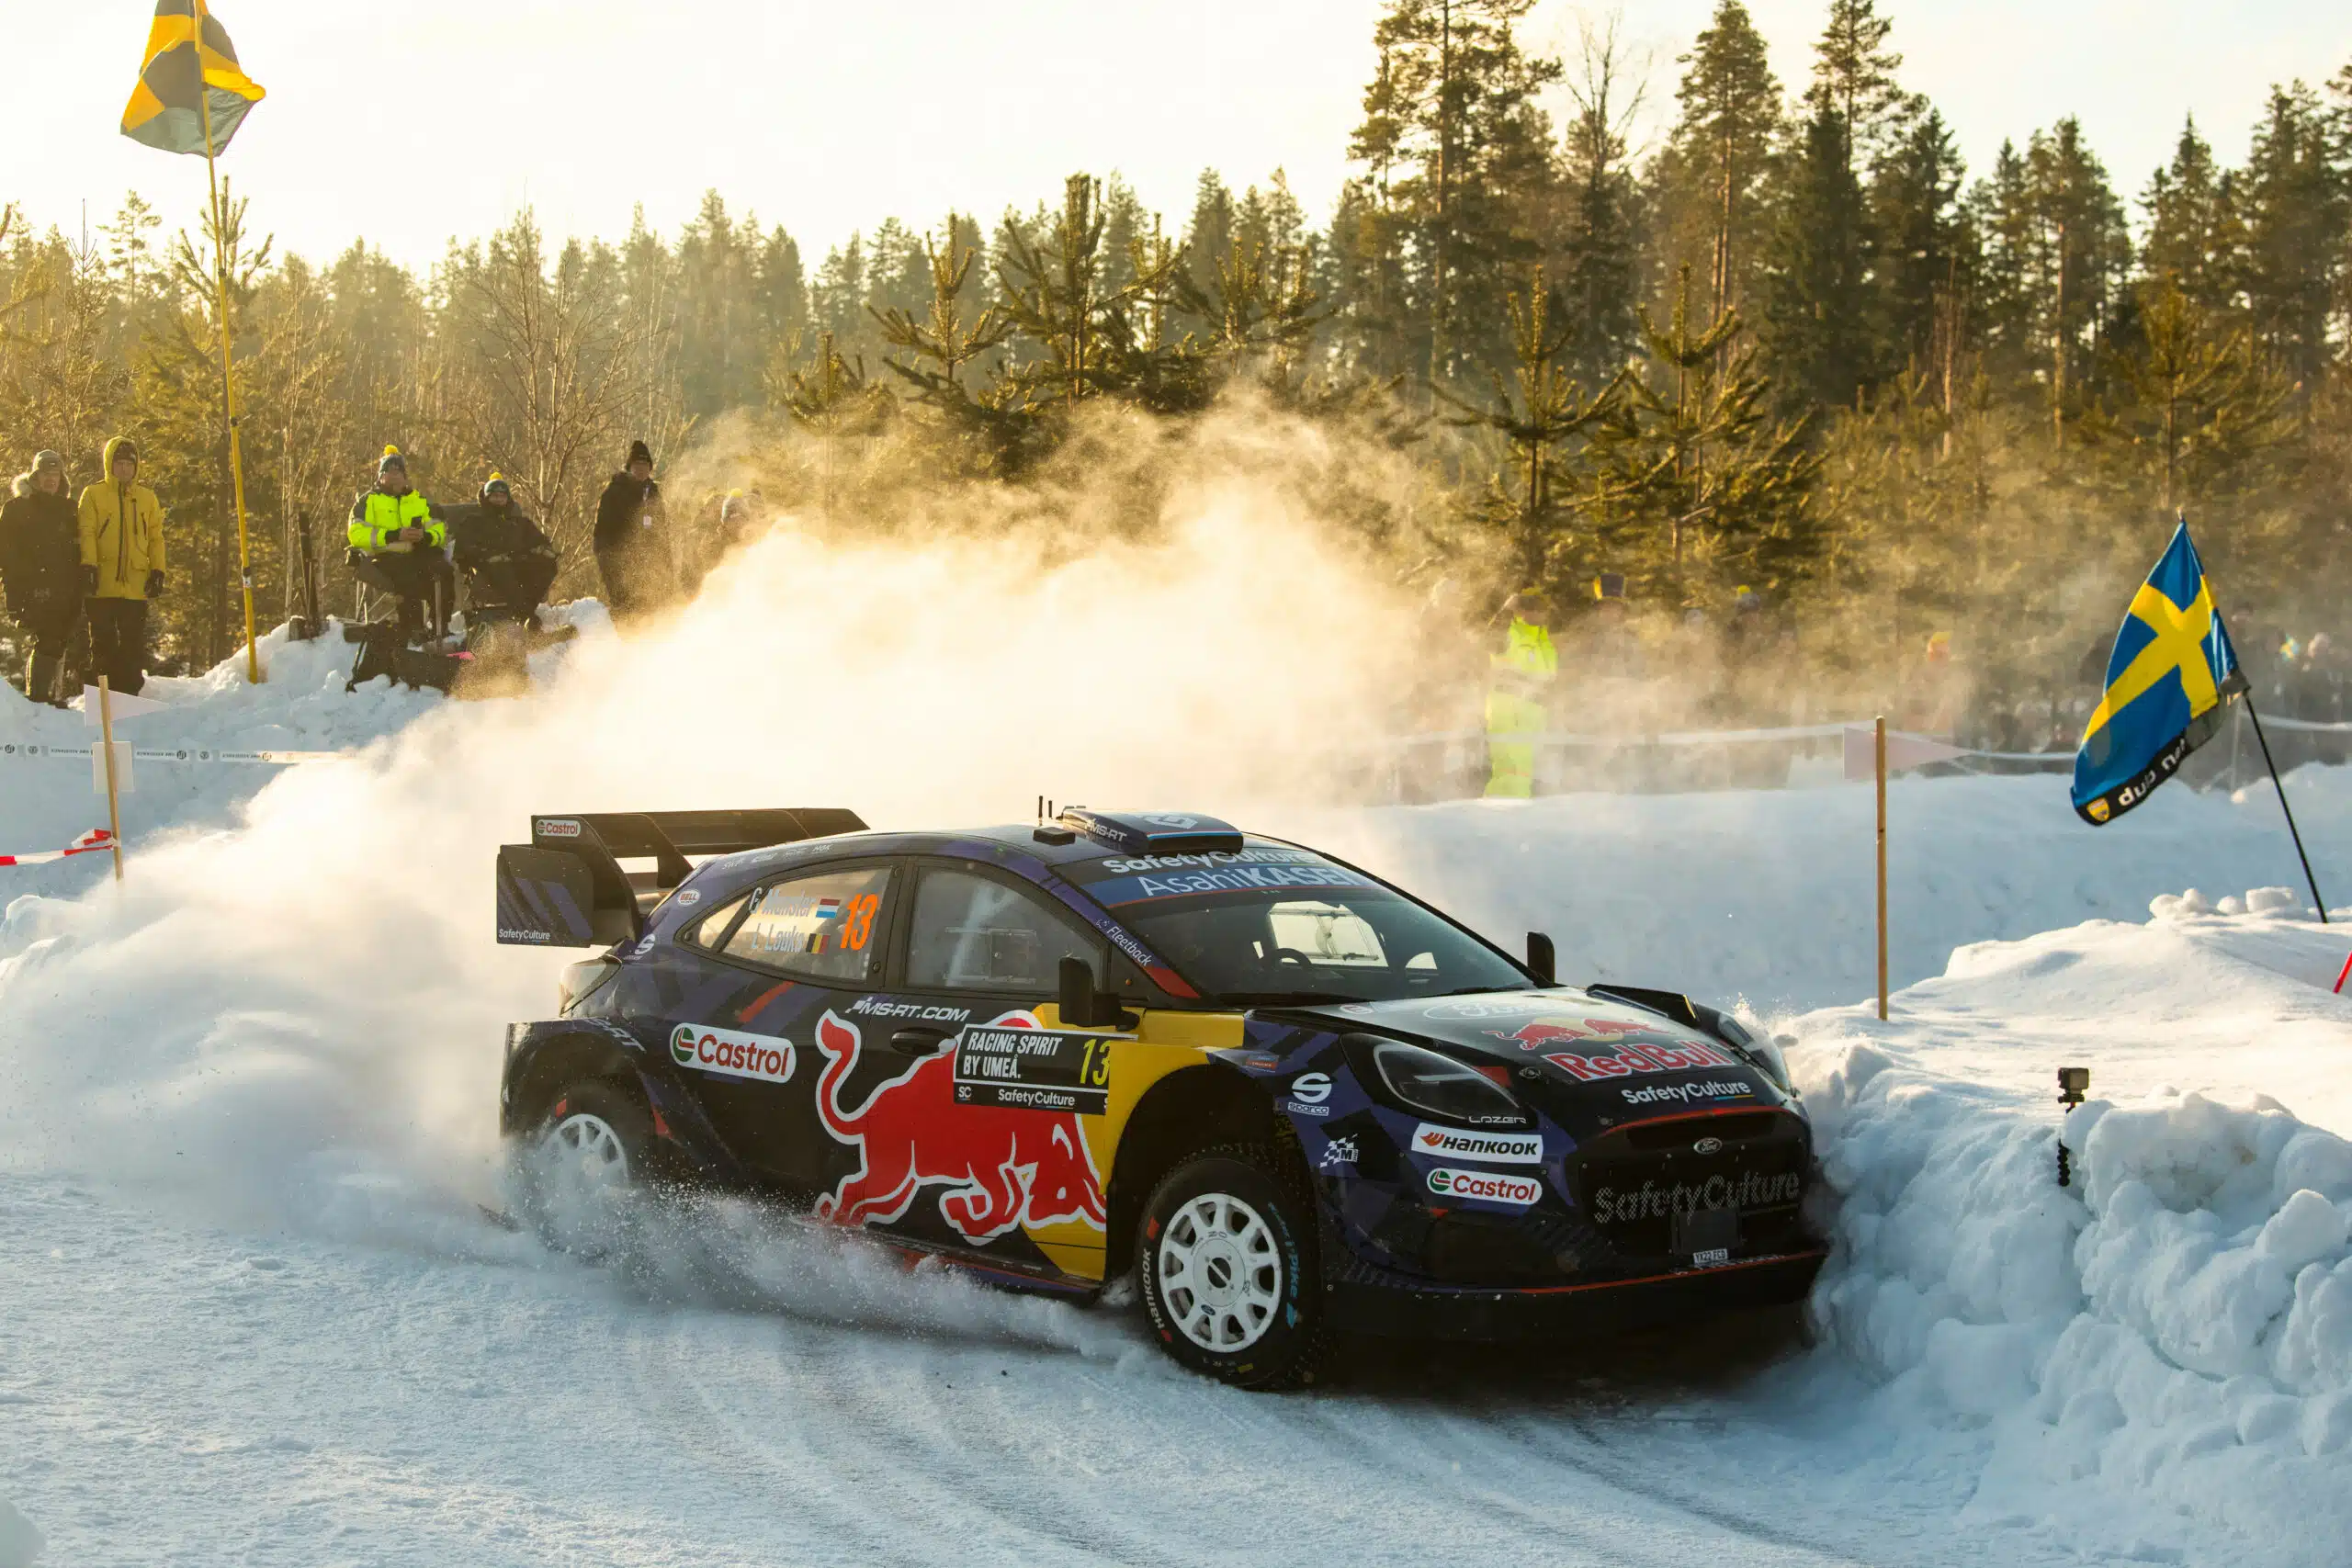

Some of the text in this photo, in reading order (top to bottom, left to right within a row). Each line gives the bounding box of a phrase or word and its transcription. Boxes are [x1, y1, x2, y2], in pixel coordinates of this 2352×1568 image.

[546, 822, 578, 835] Castrol
[1102, 851, 1321, 874] SafetyCulture
[840, 892, 878, 951] 13
[498, 928, 551, 941] SafetyCulture
[1107, 925, 1154, 966] Fleetback
[697, 1033, 790, 1077] Castrol
[967, 1032, 1063, 1056] RACING SPIRIT
[963, 1055, 981, 1076] BY
[1080, 1038, 1111, 1086] 13
[958, 1086, 1076, 1106] SC SafetyCulture
[1621, 1080, 1751, 1103] SafetyCulture
[1289, 1103, 1329, 1113] sparco
[1453, 1175, 1537, 1201] Castrol
[1593, 1171, 1801, 1225] SafetyCulture
